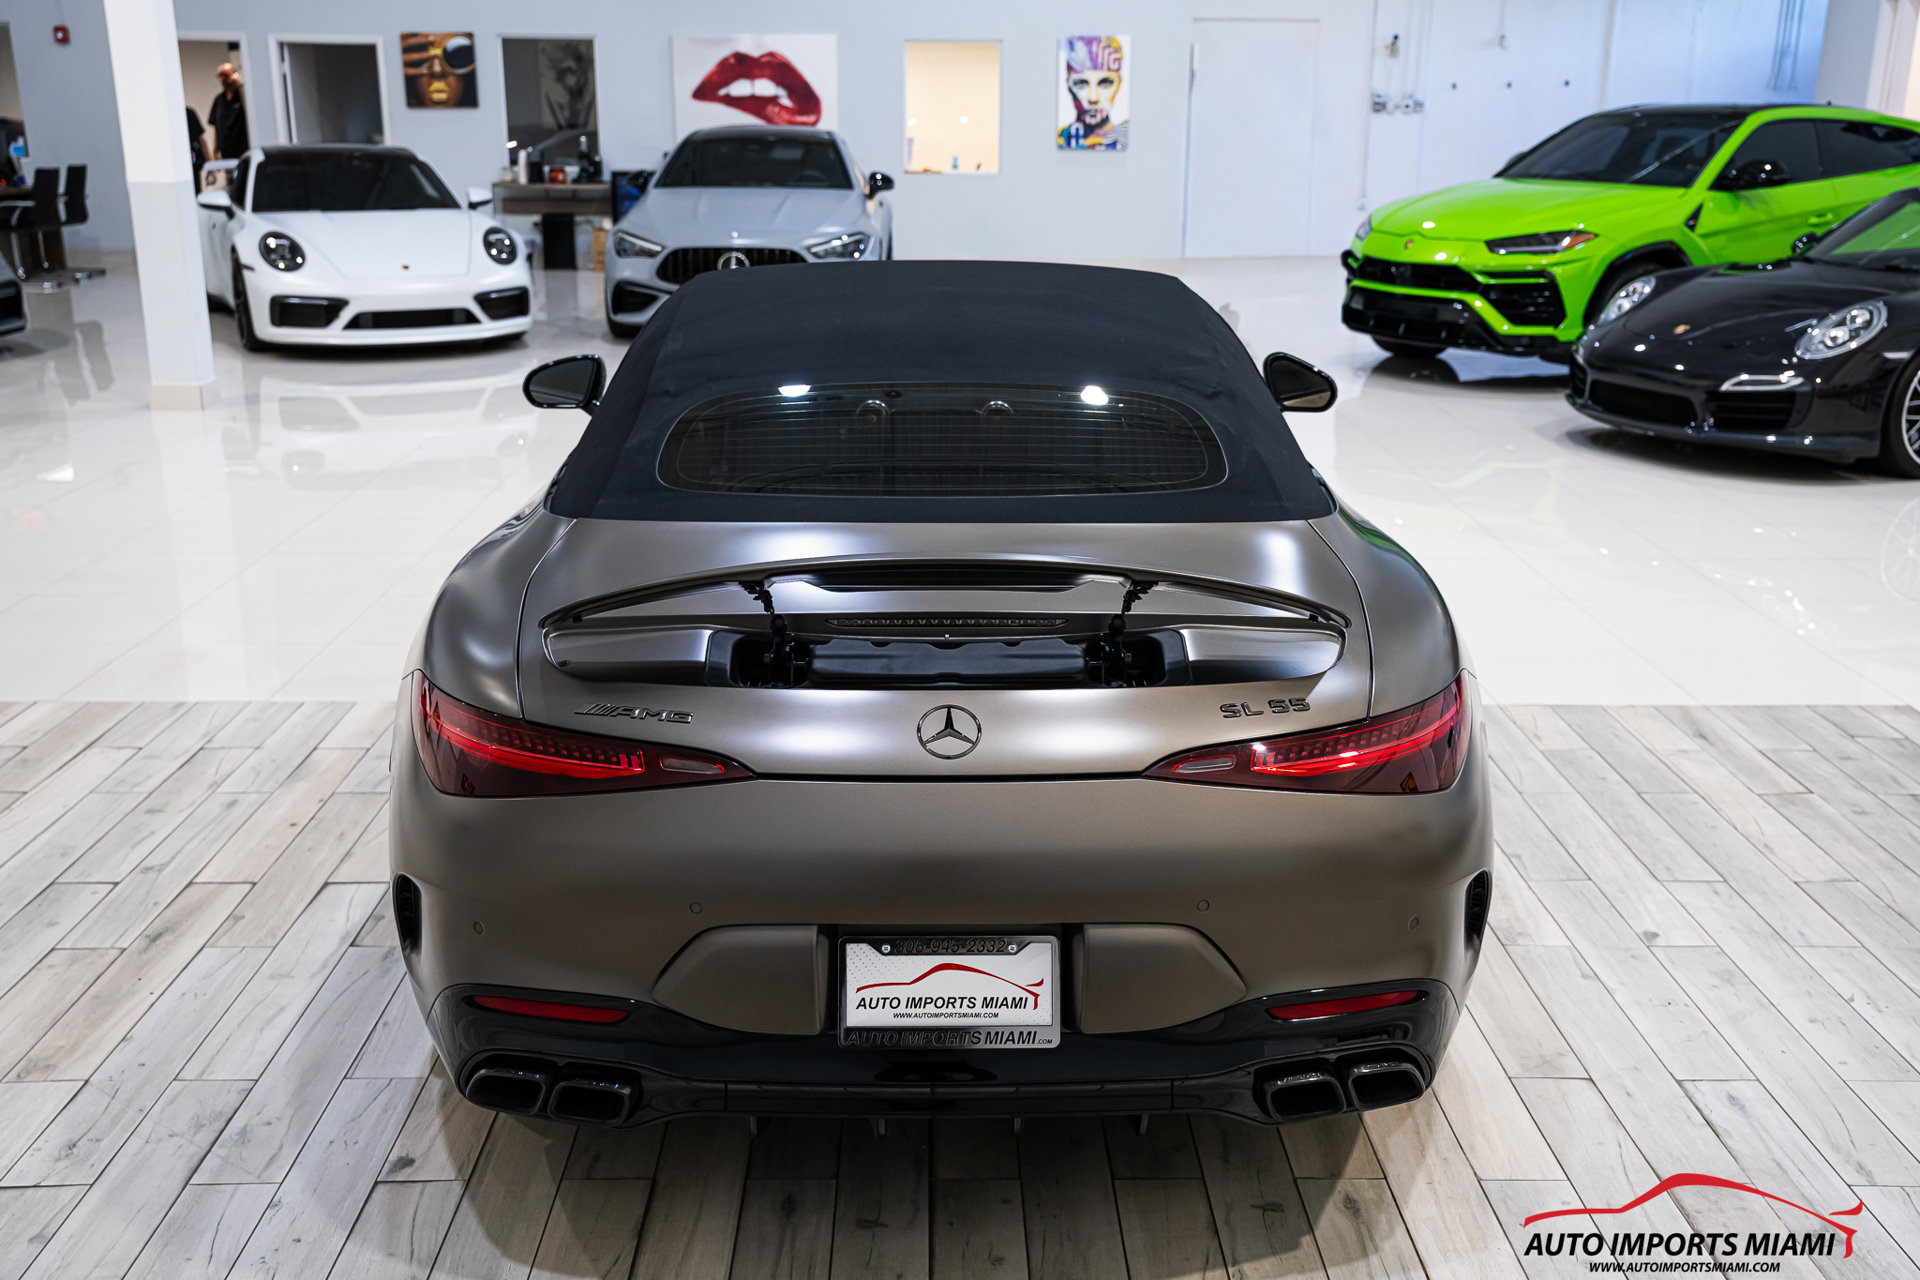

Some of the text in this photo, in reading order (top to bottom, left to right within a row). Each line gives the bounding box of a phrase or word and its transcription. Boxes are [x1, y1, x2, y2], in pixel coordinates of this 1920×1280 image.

[1220, 697, 1311, 718] SL 55
[895, 939, 1006, 953] 305-945-2332
[856, 996, 1029, 1010] AUTO IMPORTS MIAMI
[849, 1030, 898, 1046] AUTO
[900, 1030, 983, 1046] IMPORTS
